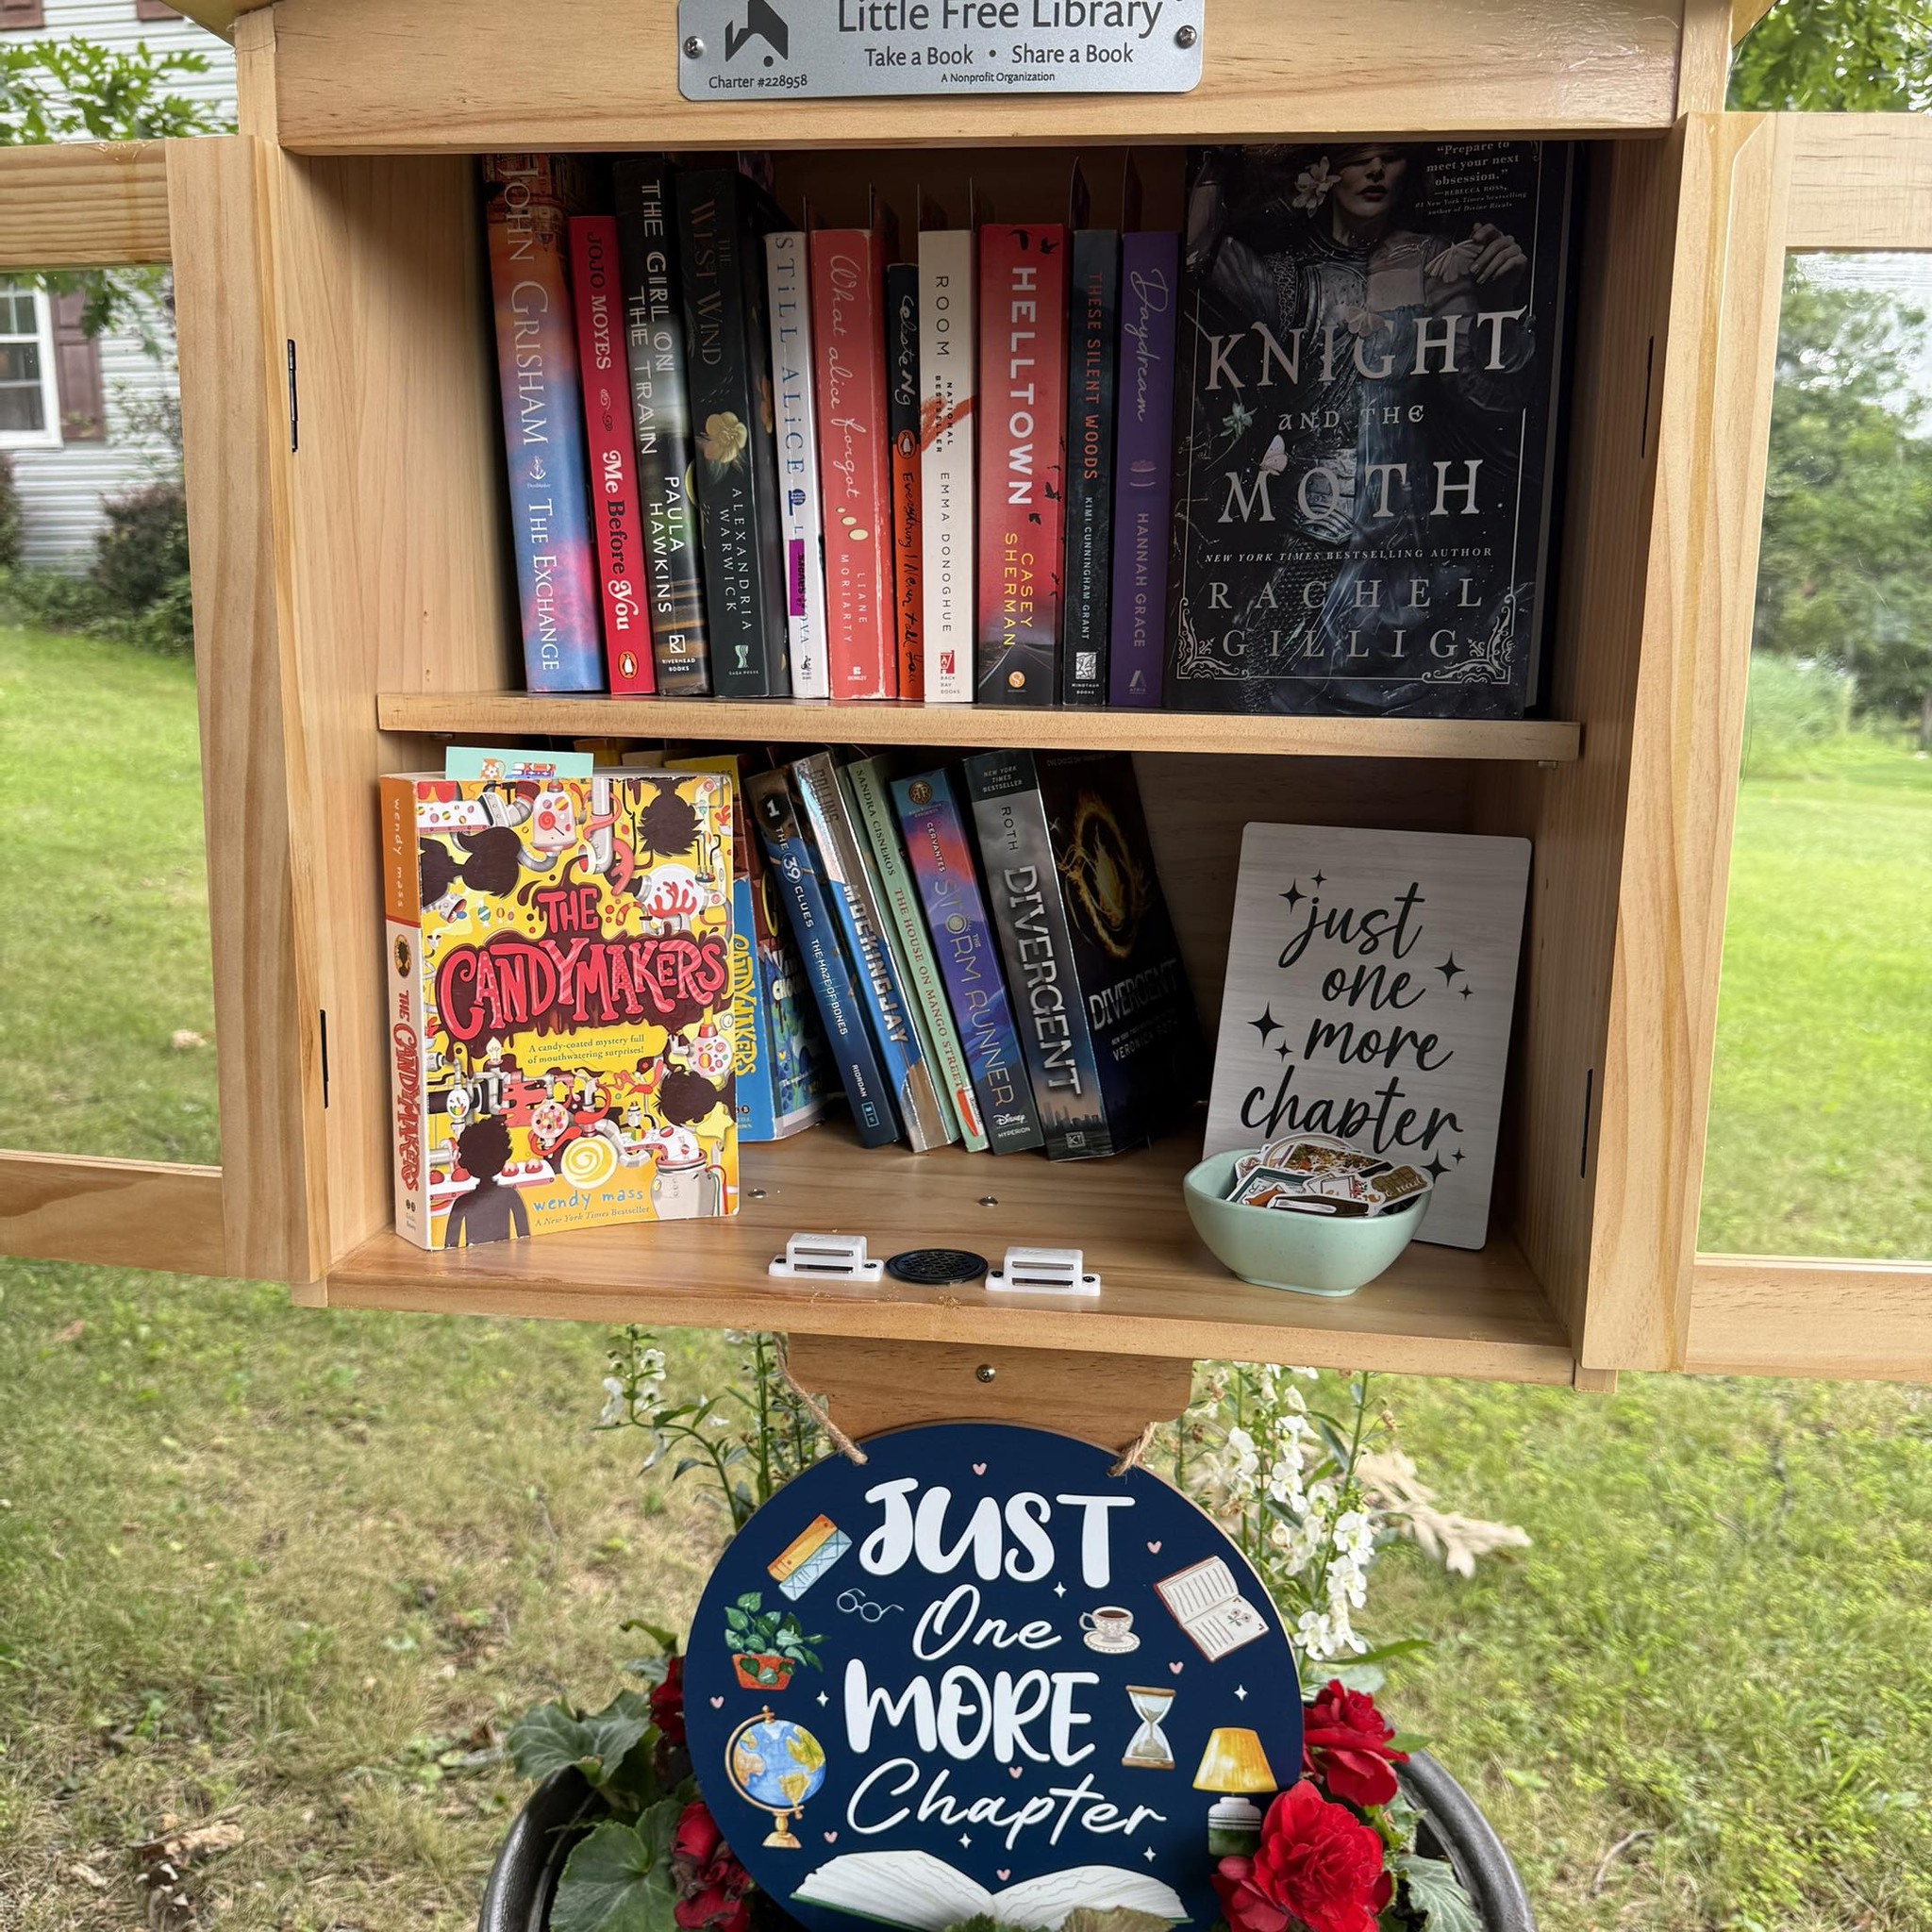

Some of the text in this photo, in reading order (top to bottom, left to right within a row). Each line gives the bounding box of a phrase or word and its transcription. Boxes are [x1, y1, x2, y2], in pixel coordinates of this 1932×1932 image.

[838, 0, 1163, 39] Little Free Library
[864, 42, 1134, 67] Take a Book Share a Book
[708, 74, 808, 90] Charter #228958
[941, 71, 1056, 85] A Nonprofit Organization
[1426, 154, 1520, 173] meet your next
[498, 168, 538, 261] JOHN
[718, 238, 732, 264] THE
[588, 232, 611, 370] JOJO MOYES
[641, 179, 675, 372] THE GIRL ON
[690, 200, 724, 365] WEST WIND
[936, 275, 950, 356] ROOM
[1124, 268, 1169, 423] Daydream
[1205, 305, 1528, 391] KNIGHT
[511, 280, 548, 445] GRISHAM
[628, 286, 658, 455] THE TRAIN
[828, 255, 866, 498] What alice forgot
[894, 371, 916, 406] Ng
[1008, 267, 1037, 505] HELLTOWN
[1084, 273, 1103, 479] THESE SILENT WOODS
[1359, 405, 1425, 425] THE
[528, 499, 553, 543] THE
[664, 476, 685, 552] PAULA
[898, 472, 920, 549] Everything
[1217, 458, 1484, 525] MOTH
[602, 450, 639, 631] Me Before You
[649, 503, 672, 613] HAWKINS
[719, 508, 738, 612] WARWICK
[732, 488, 753, 630] ALEXANDRIA
[905, 554, 912, 563] I
[941, 472, 952, 632] EMMA DONOGHUE
[1080, 496, 1092, 640] KIMI CUNNINGHAM GRANT
[1205, 547, 1492, 563] NEW YORK TIMES BESTSELLING AUTHOR
[533, 555, 559, 670] EXCHANGE
[840, 554, 852, 643] MORIARTY
[857, 572, 868, 624] LIANE
[902, 563, 920, 608] Never
[1003, 532, 1018, 646] SHERMAN
[1020, 553, 1033, 629] CASEY
[1134, 512, 1149, 647] HANNAH GRACE
[1208, 578, 1483, 610] RACHEL
[1223, 629, 1458, 658] GILLIG
[766, 799, 780, 818] 1
[811, 769, 840, 823] COLLINS
[982, 779, 1024, 793] BESTSELLER
[983, 765, 1017, 778] NEW YORK
[991, 774, 1012, 784] TIMES
[392, 798, 402, 856] wendy
[856, 769, 896, 876] SANDRA CISNEROS
[926, 822, 946, 873] CERVANTES
[1001, 806, 1019, 851] ROTH
[537, 890, 599, 933] THE
[775, 827, 815, 928] THE 39 CLUES
[843, 884, 908, 1041] MOCKINGJAY
[973, 933, 981, 949] THE
[1278, 881, 1425, 968] just
[398, 990, 409, 1023] THE
[441, 937, 727, 1039] CANDYMAKERS
[810, 938, 848, 1035] THE MAZE OF BONES
[895, 889, 963, 1088] THE HOUSE ON MANGO STREET
[1004, 864, 1082, 1095] DIVERGENT
[1088, 958, 1177, 1030] DIVERGENT
[1322, 964, 1426, 1010] one
[527, 1046, 644, 1064] of mouthwatering surprises!
[529, 1034, 644, 1053] A candy-coated mystery full
[852, 1064, 868, 1098] RIORDAN
[965, 990, 1015, 1107] RUNNER
[1304, 1018, 1454, 1072] more
[392, 1023, 421, 1192] CANDYMAKERS
[992, 1113, 1026, 1124] Disney
[997, 1126, 1031, 1138] HYPERION
[1241, 1064, 1464, 1155] chapter
[534, 1189, 643, 1211] wendy mass
[544, 1217, 562, 1225] New
[564, 1213, 583, 1223] York
[586, 1211, 609, 1221] Times
[611, 1207, 650, 1217] Bestseller
[858, 1476, 1136, 1589] JUST
[912, 1583, 1063, 1661] One
[844, 1657, 1101, 1767] MORE
[847, 1757, 1167, 1850] Chapter
